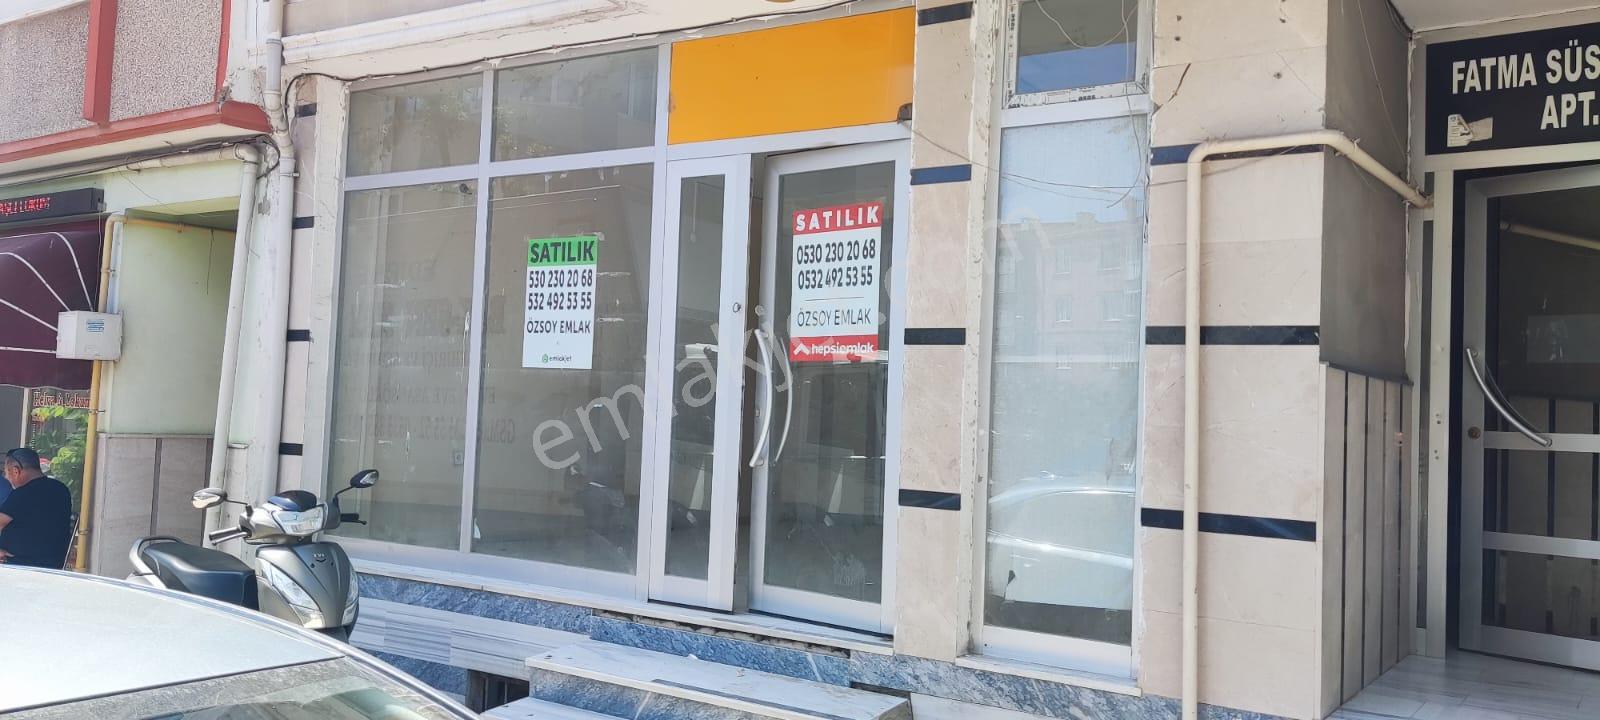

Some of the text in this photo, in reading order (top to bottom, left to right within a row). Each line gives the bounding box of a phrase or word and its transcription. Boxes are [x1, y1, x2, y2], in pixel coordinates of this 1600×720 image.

[1452, 40, 1600, 94] FATMA SÜS
[1540, 91, 1599, 130] APT.
[796, 206, 878, 232] SATILIK
[530, 240, 595, 264] SATILIK
[796, 238, 876, 265] 0530 230 20 68
[529, 269, 592, 288] 530 230 20 68
[798, 265, 872, 290] 0532 492 53 55
[528, 292, 592, 310] 532 492 53 55
[526, 317, 590, 334] ÖZSOY EMLAK
[797, 308, 871, 327] ÖZSOY EMLAK
[812, 342, 874, 356] hepsiemlak
